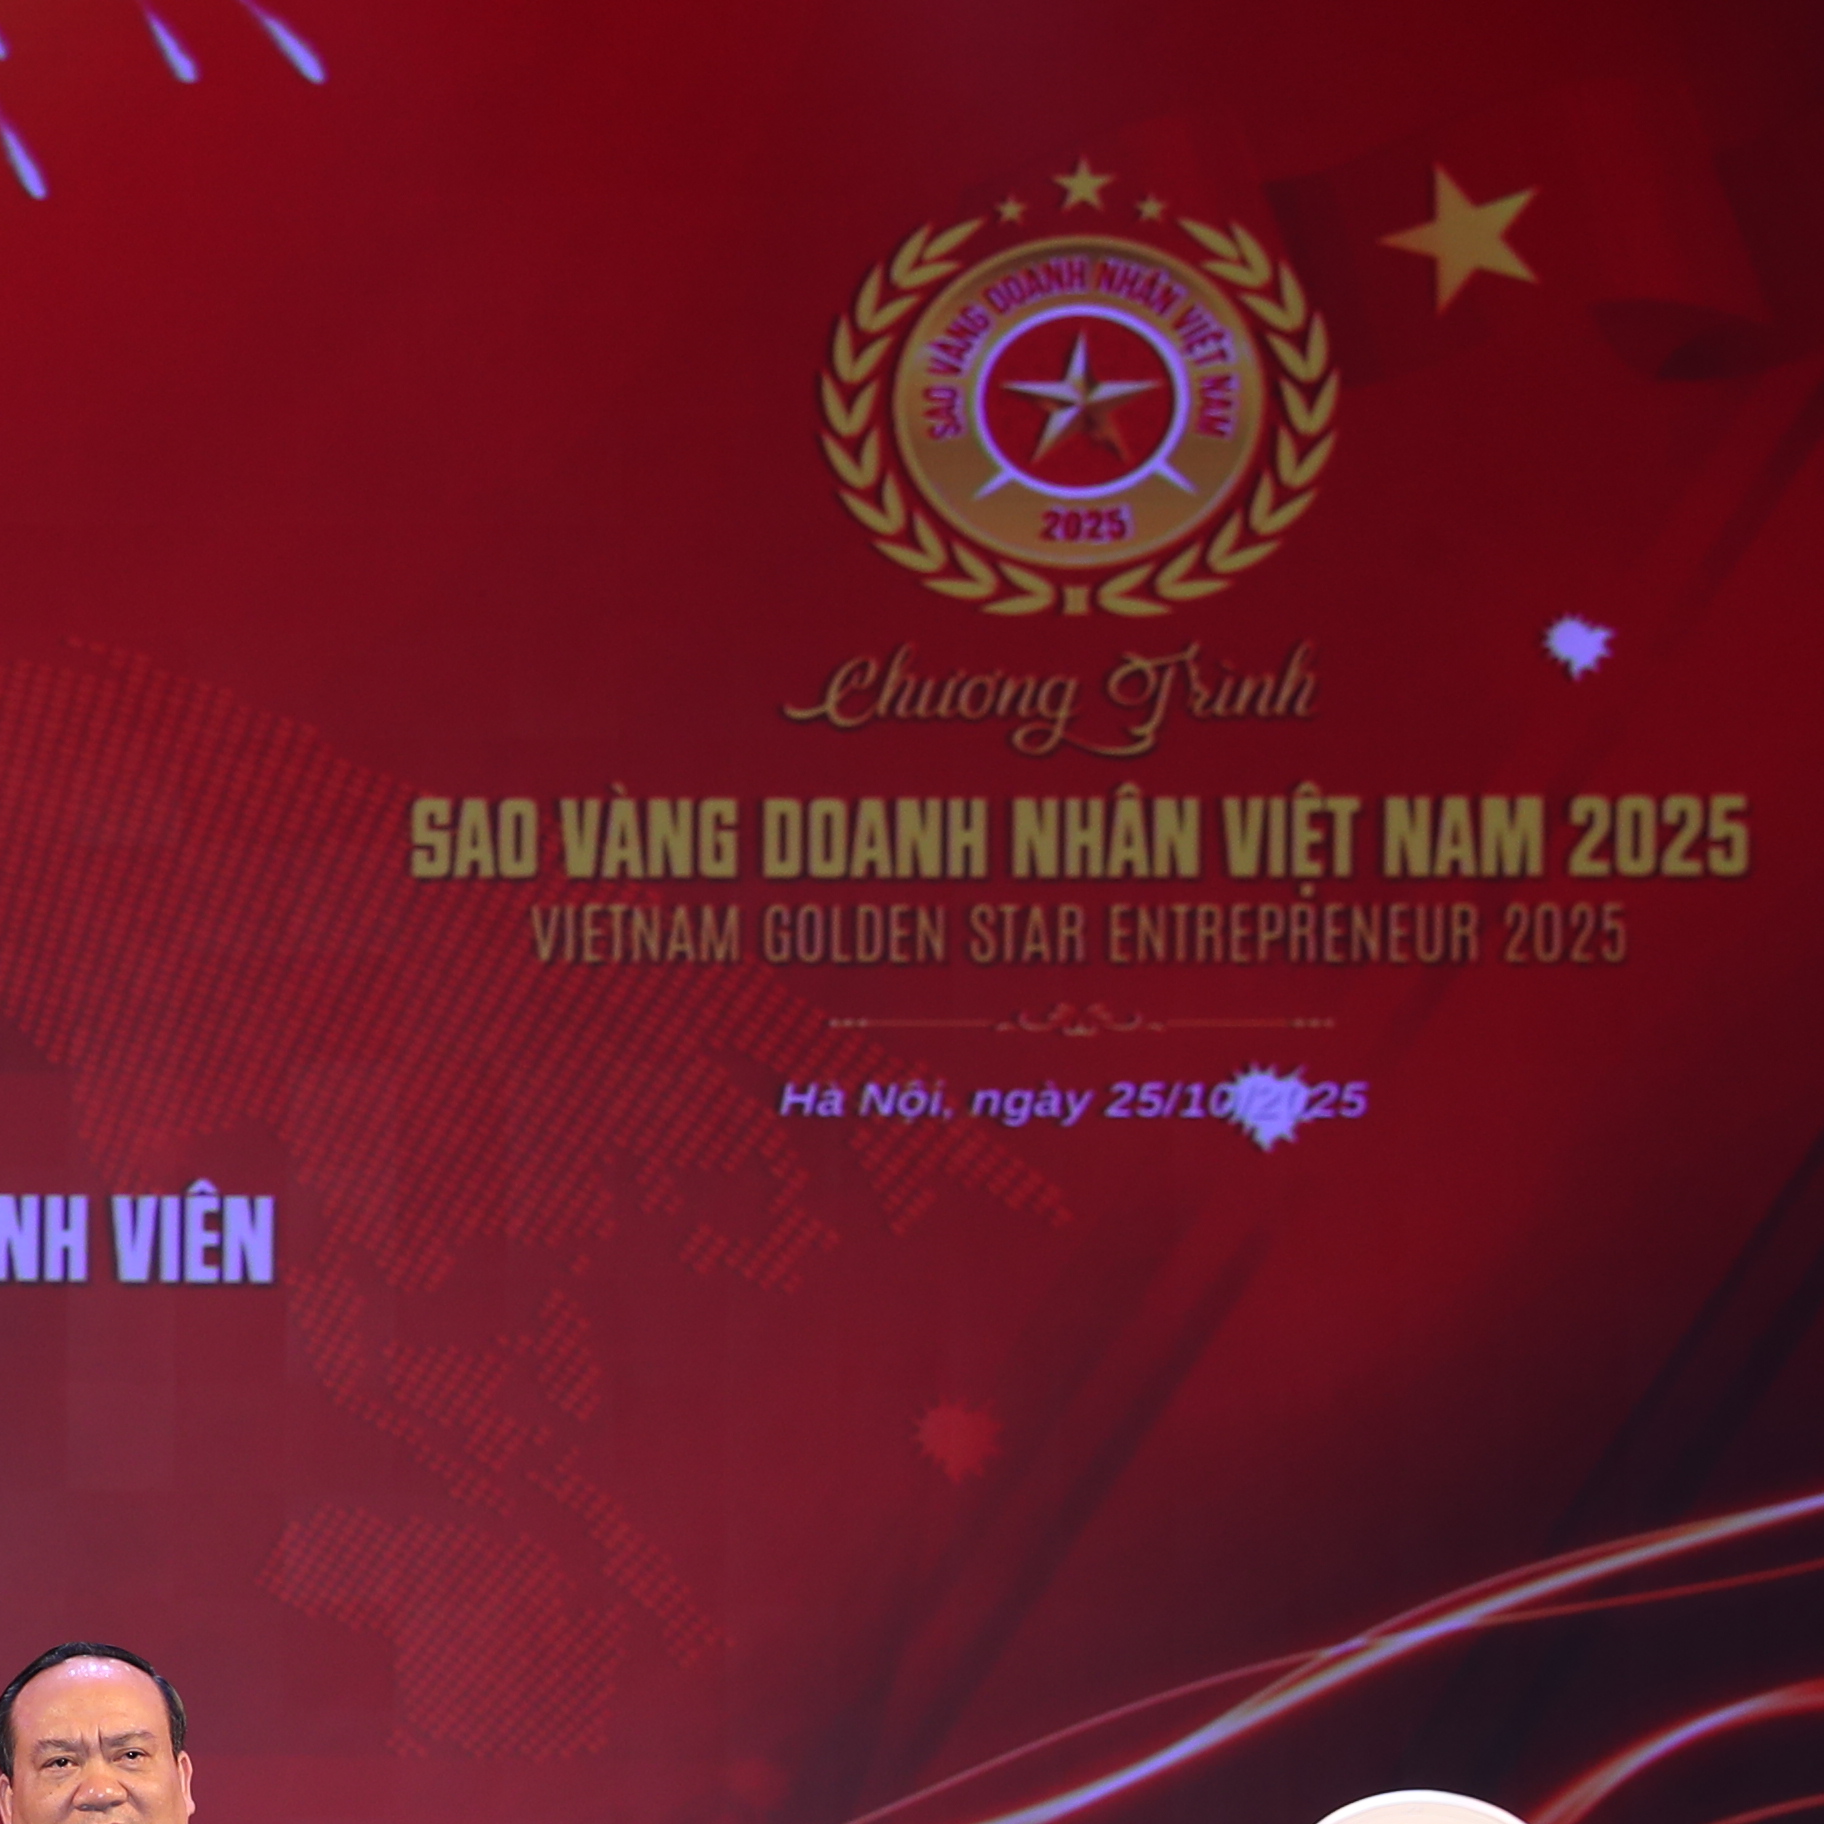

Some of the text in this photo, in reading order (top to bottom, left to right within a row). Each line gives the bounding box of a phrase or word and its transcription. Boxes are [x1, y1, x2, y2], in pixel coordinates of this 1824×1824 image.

[922, 384, 964, 440] SAO
[984, 255, 1090, 315] DOANH
[1197, 373, 1239, 440] NAM
[1040, 504, 1133, 543] 2025
[784, 640, 1318, 756] Chương Trình
[411, 782, 1749, 898] SAO VÀNG DOANH NHÂN VIỆT NAM 2025
[530, 902, 1629, 964] VIETNAM GOLDEN STAR ENTREPRENEUR 2025
[779, 1081, 845, 1118] Hà
[858, 1080, 952, 1124] Nội,
[971, 1081, 1093, 1127] ngày
[110, 1178, 274, 1284] VIÊN
